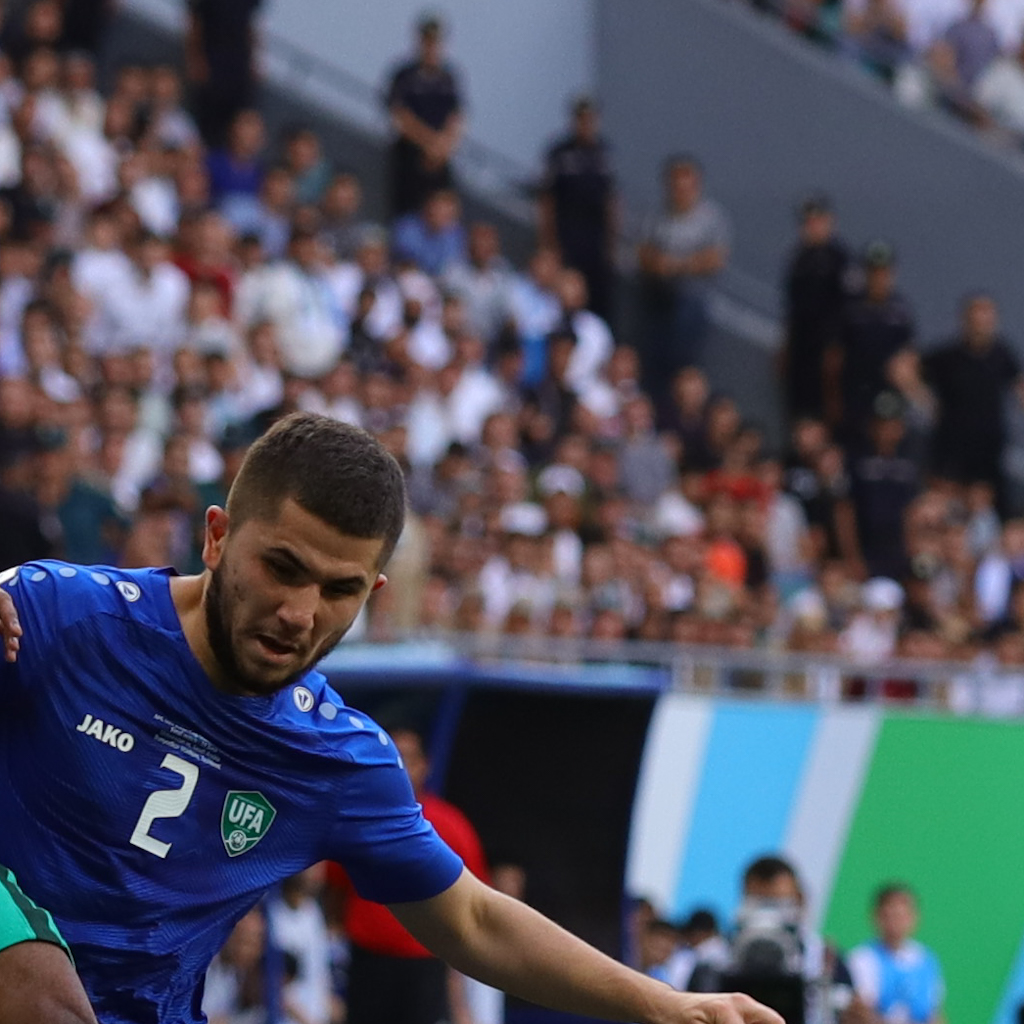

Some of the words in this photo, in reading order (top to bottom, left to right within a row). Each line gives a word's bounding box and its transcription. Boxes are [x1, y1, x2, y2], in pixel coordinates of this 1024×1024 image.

[76, 713, 134, 753] JAKO
[129, 752, 199, 859] 2
[228, 798, 264, 834] UFA
